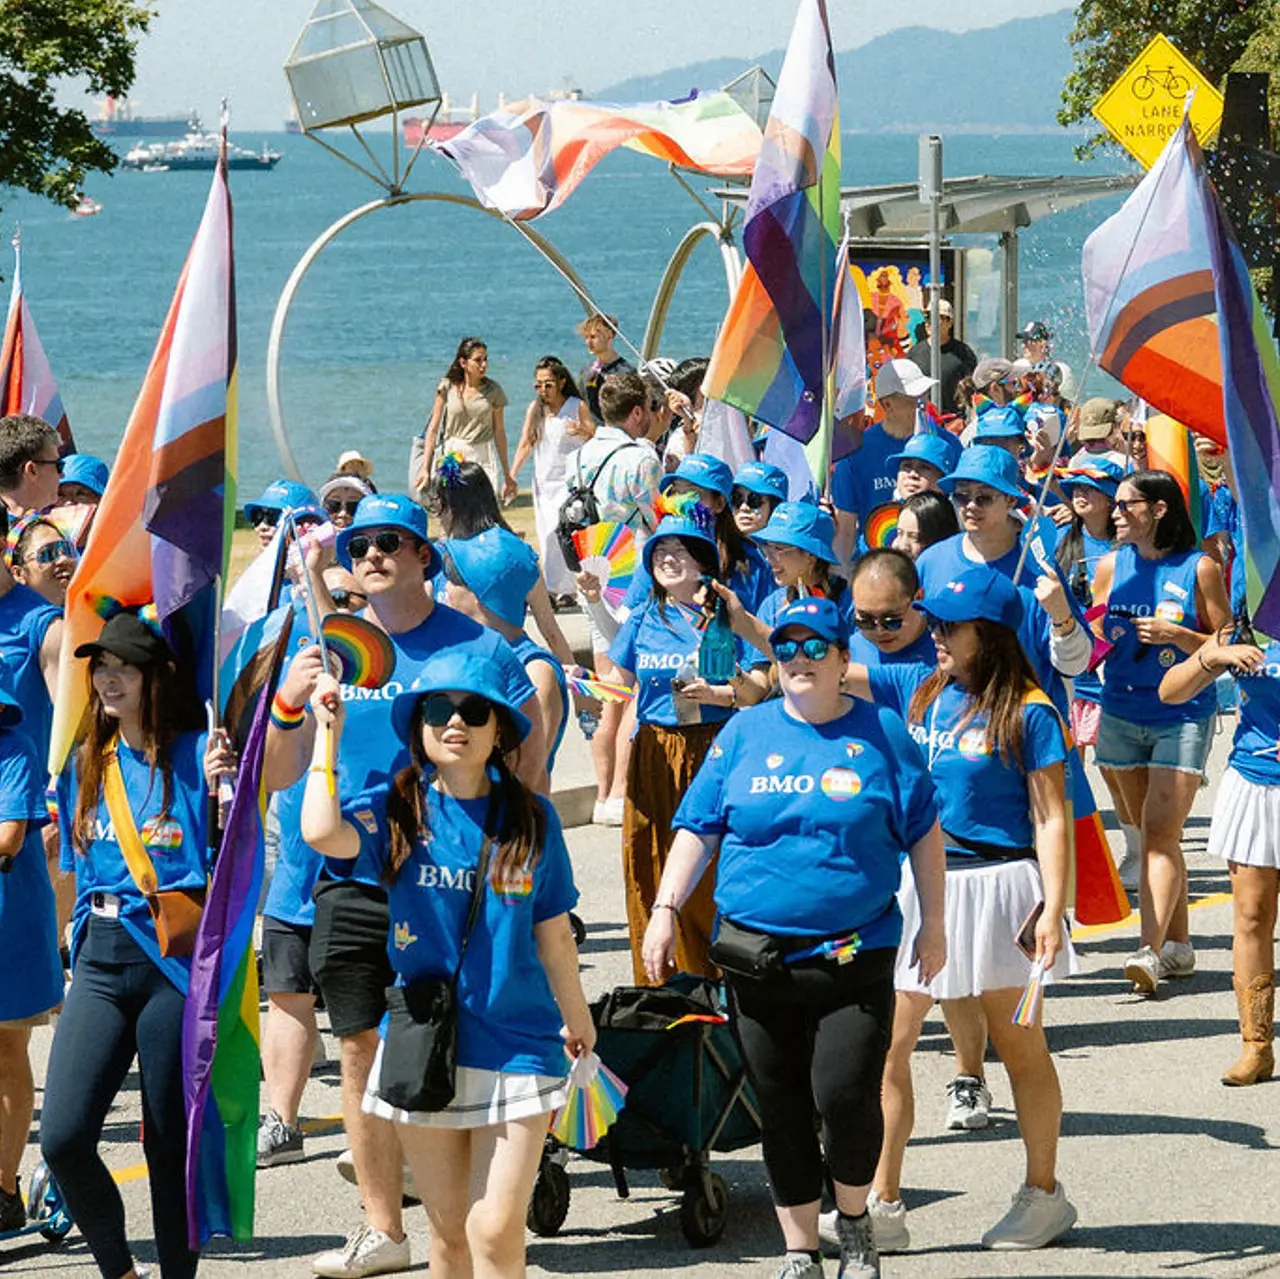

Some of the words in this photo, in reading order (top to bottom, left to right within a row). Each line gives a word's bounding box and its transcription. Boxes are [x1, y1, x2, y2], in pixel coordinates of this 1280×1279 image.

[1142, 105, 1181, 119] LANE
[1125, 122, 1202, 138] NARROS
[873, 476, 897, 491] BM
[638, 652, 684, 670] BMO
[339, 681, 404, 702] BMO
[749, 774, 815, 795] BMO
